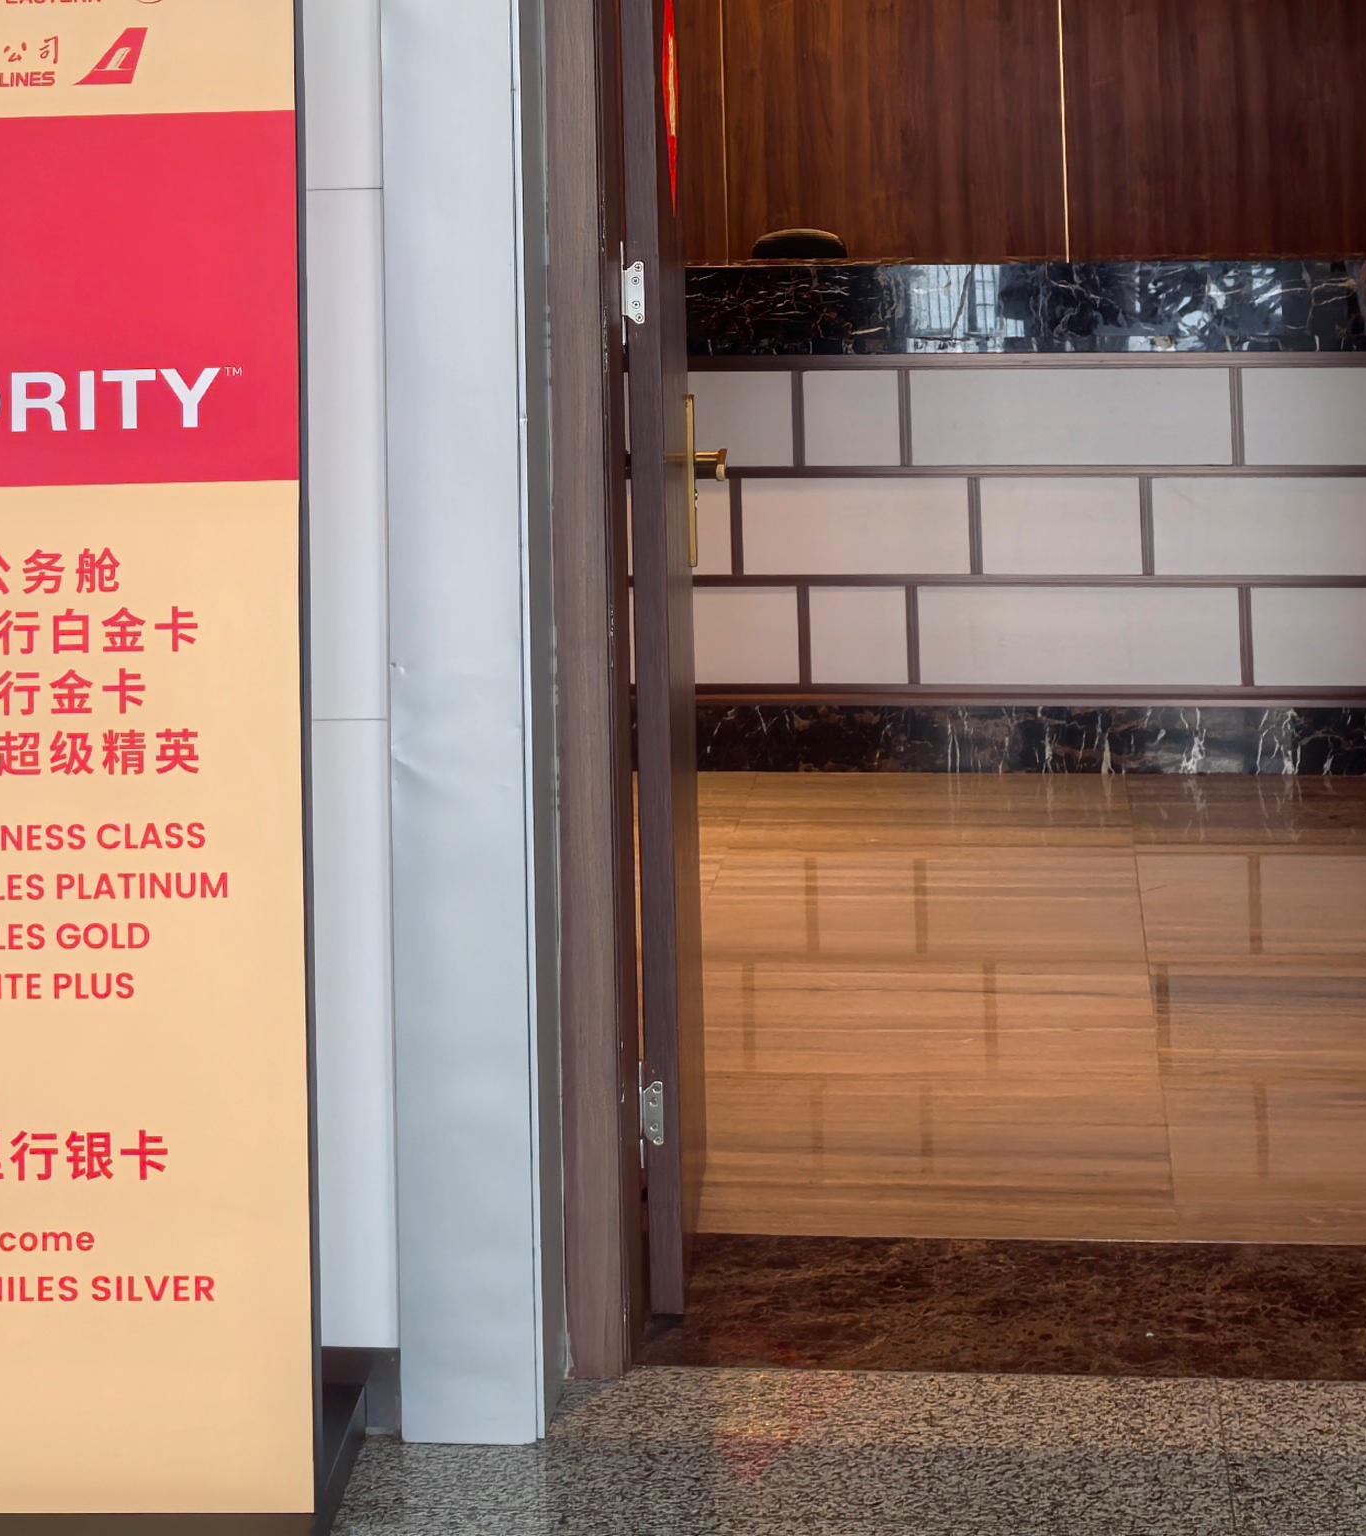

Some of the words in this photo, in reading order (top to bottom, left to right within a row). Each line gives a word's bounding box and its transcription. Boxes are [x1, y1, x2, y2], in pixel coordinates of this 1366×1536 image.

[96, 822, 207, 850] CLASS
[56, 871, 229, 900] PLATINUM
[55, 922, 151, 950] GOLD
[52, 972, 135, 1000] PLUS
[91, 1275, 216, 1302] SILVER
